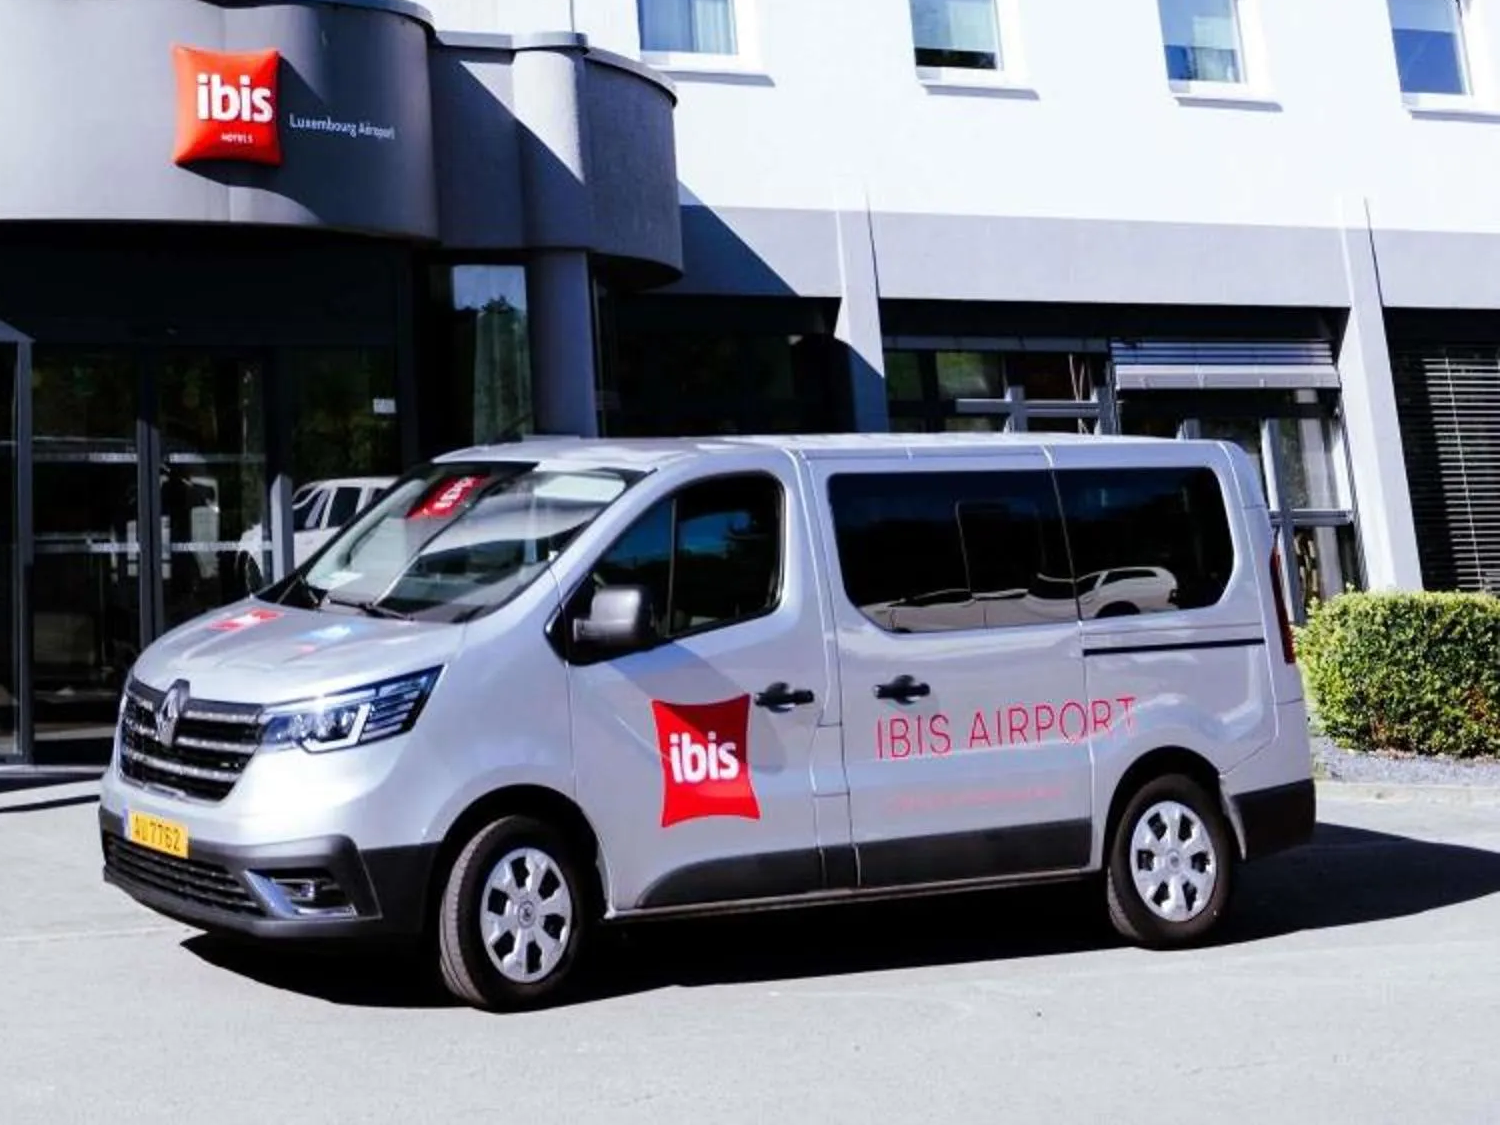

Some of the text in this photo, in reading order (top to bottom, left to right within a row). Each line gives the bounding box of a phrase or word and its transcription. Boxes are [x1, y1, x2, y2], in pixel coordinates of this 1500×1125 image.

[196, 73, 273, 123] ibis
[289, 113, 357, 138] Luxembourg
[876, 695, 1137, 760] IBIS AIRPORT
[669, 730, 741, 784] ibis
